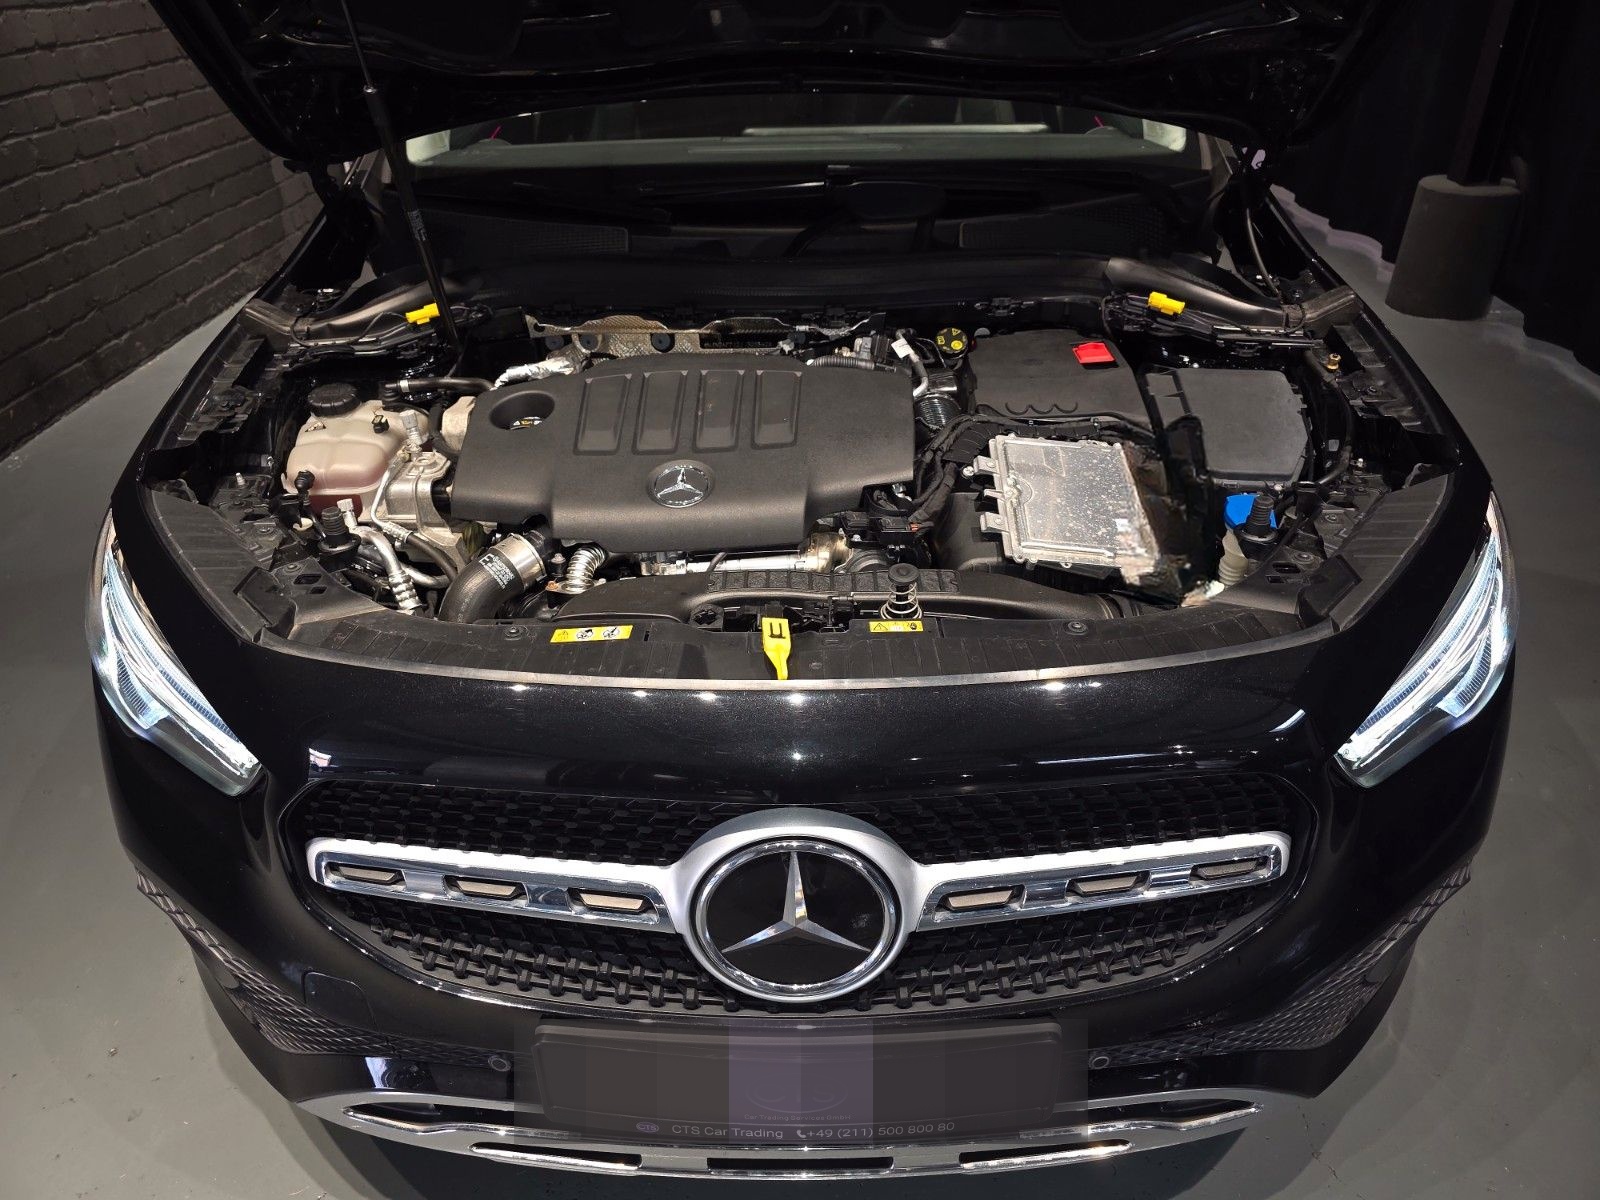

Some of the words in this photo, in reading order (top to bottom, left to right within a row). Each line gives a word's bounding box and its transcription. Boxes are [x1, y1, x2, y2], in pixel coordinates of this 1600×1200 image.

[759, 1114, 789, 1122] Trading
[638, 1123, 657, 1132] CTS
[671, 1124, 700, 1135] CTS
[704, 1127, 728, 1136] Car
[731, 1127, 784, 1139] Trading
[806, 1128, 833, 1138] +49
[837, 1127, 874, 1139] (211)
[878, 1126, 904, 1136] 500
[908, 1124, 934, 1134] 800
[937, 1122, 955, 1132] 80
